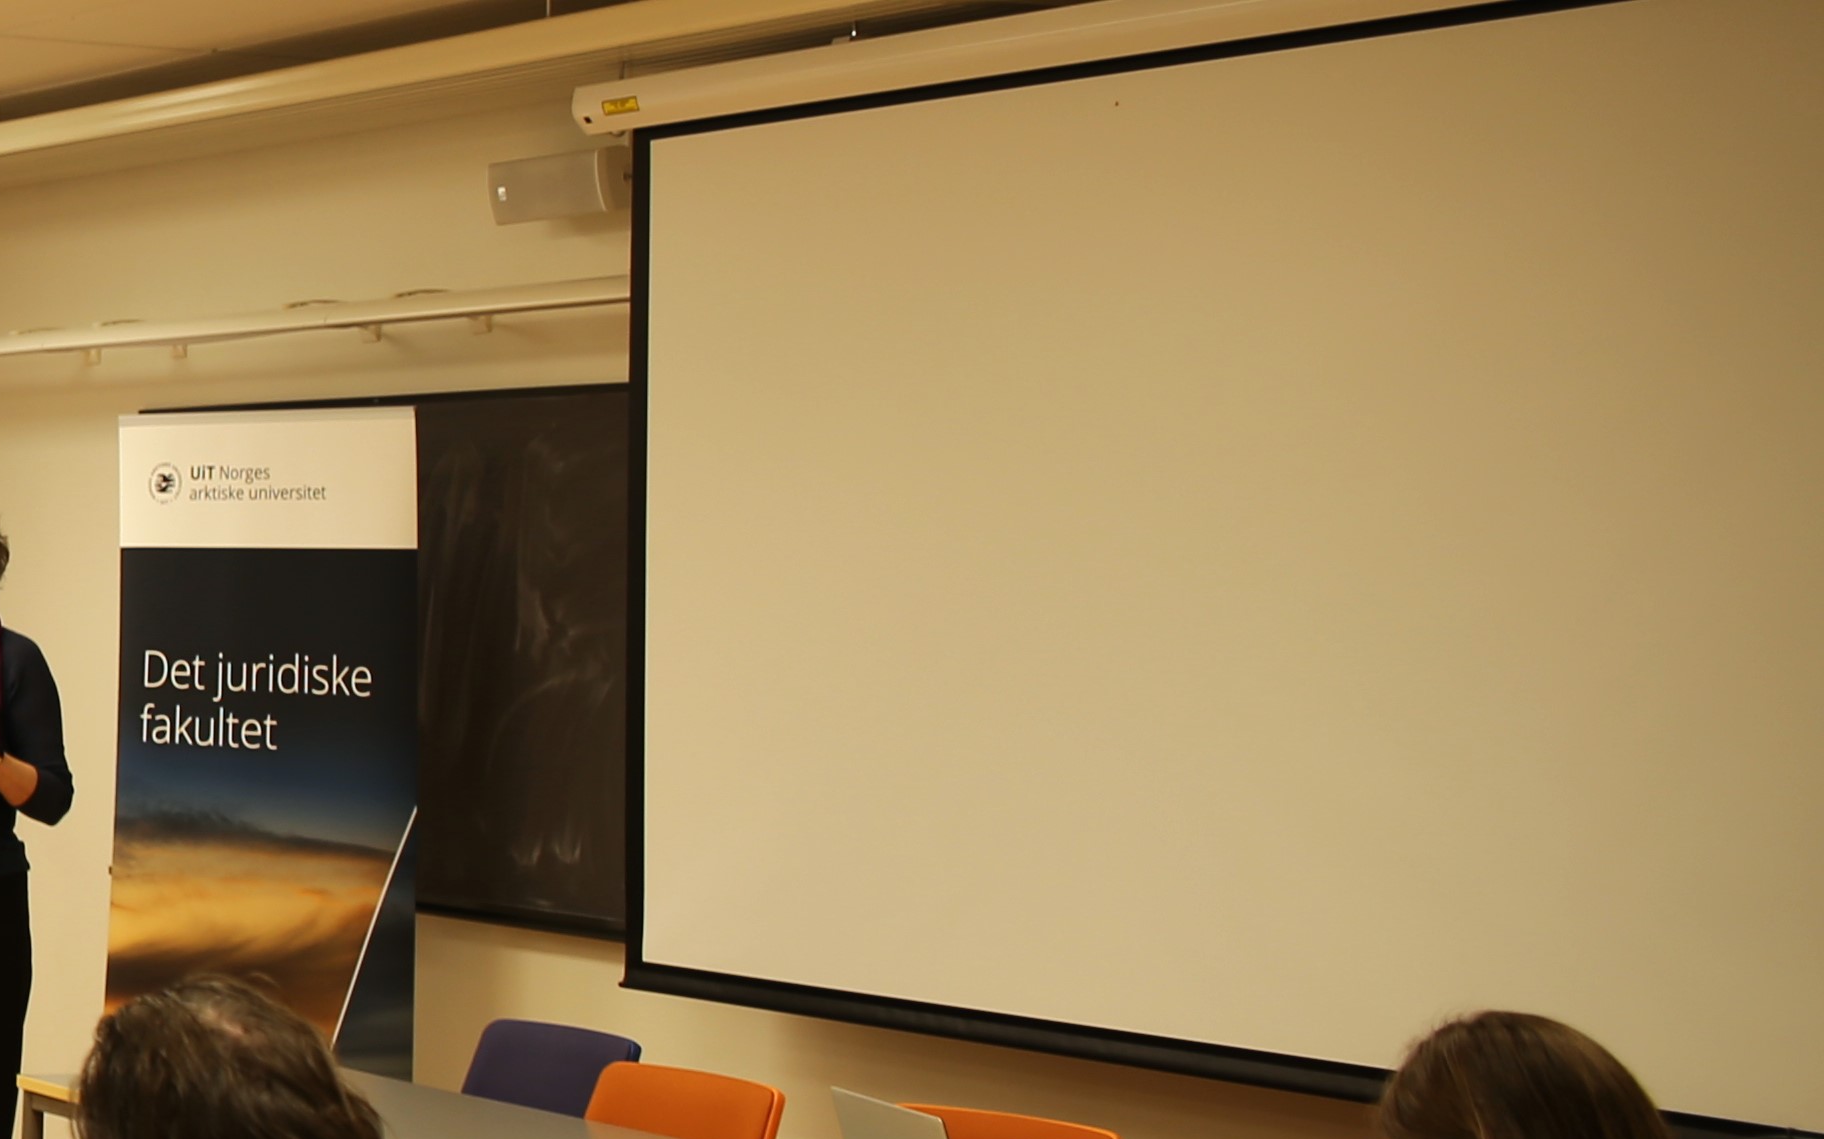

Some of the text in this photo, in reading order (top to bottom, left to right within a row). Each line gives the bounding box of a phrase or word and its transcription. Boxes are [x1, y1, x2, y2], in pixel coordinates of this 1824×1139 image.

[190, 464, 271, 484] UiT Norges
[189, 485, 327, 501] arktiske universitet
[143, 649, 373, 703] Det juridiske
[140, 702, 278, 751] fakultet
